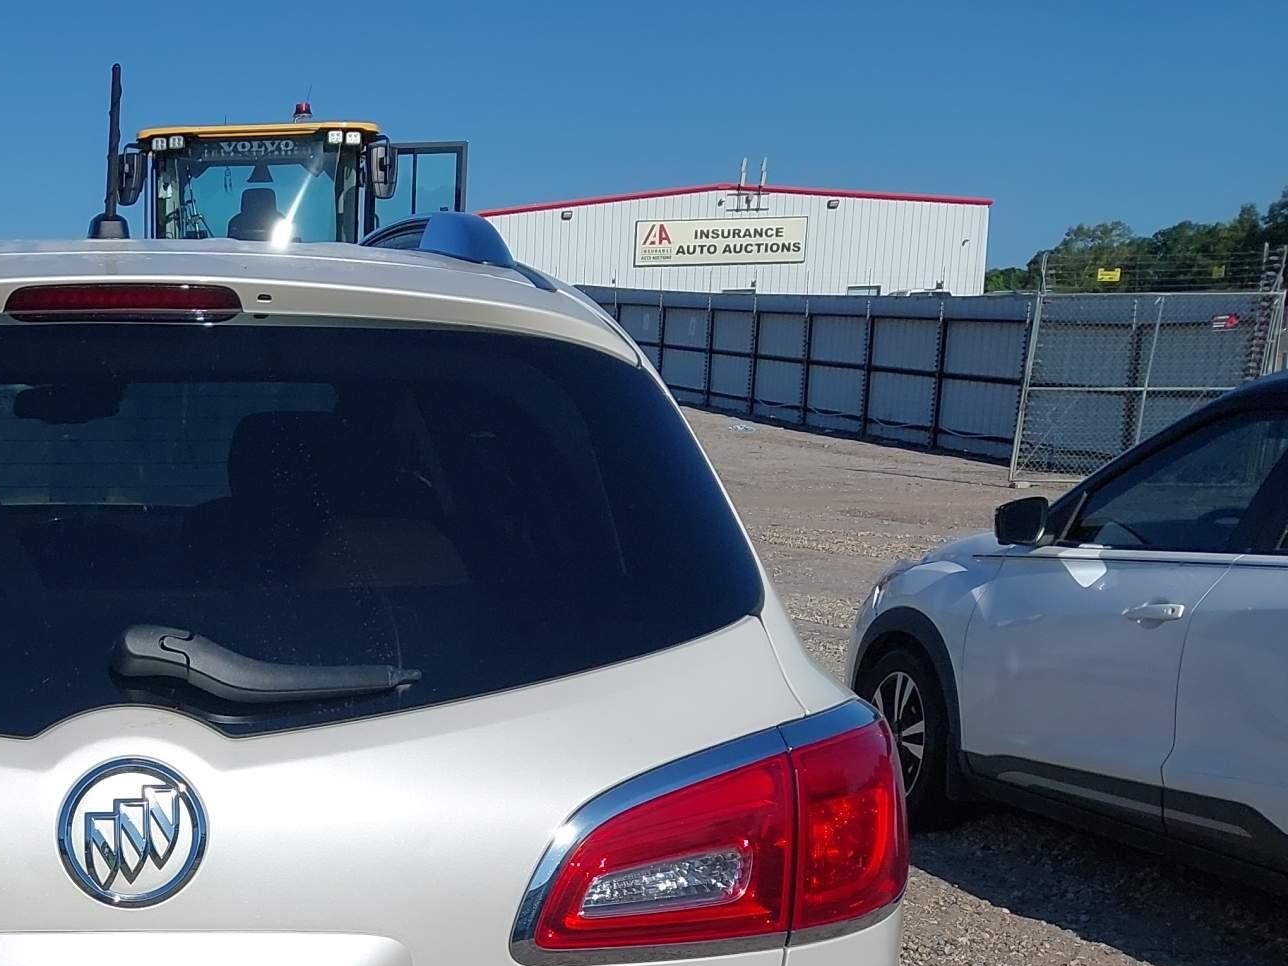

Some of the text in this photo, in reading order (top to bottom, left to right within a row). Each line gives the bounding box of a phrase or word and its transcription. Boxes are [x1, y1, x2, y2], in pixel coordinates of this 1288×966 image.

[220, 140, 294, 153] VOLVO
[694, 227, 785, 240] INSURANCE
[675, 242, 801, 256] AUTO AUCTIONS
